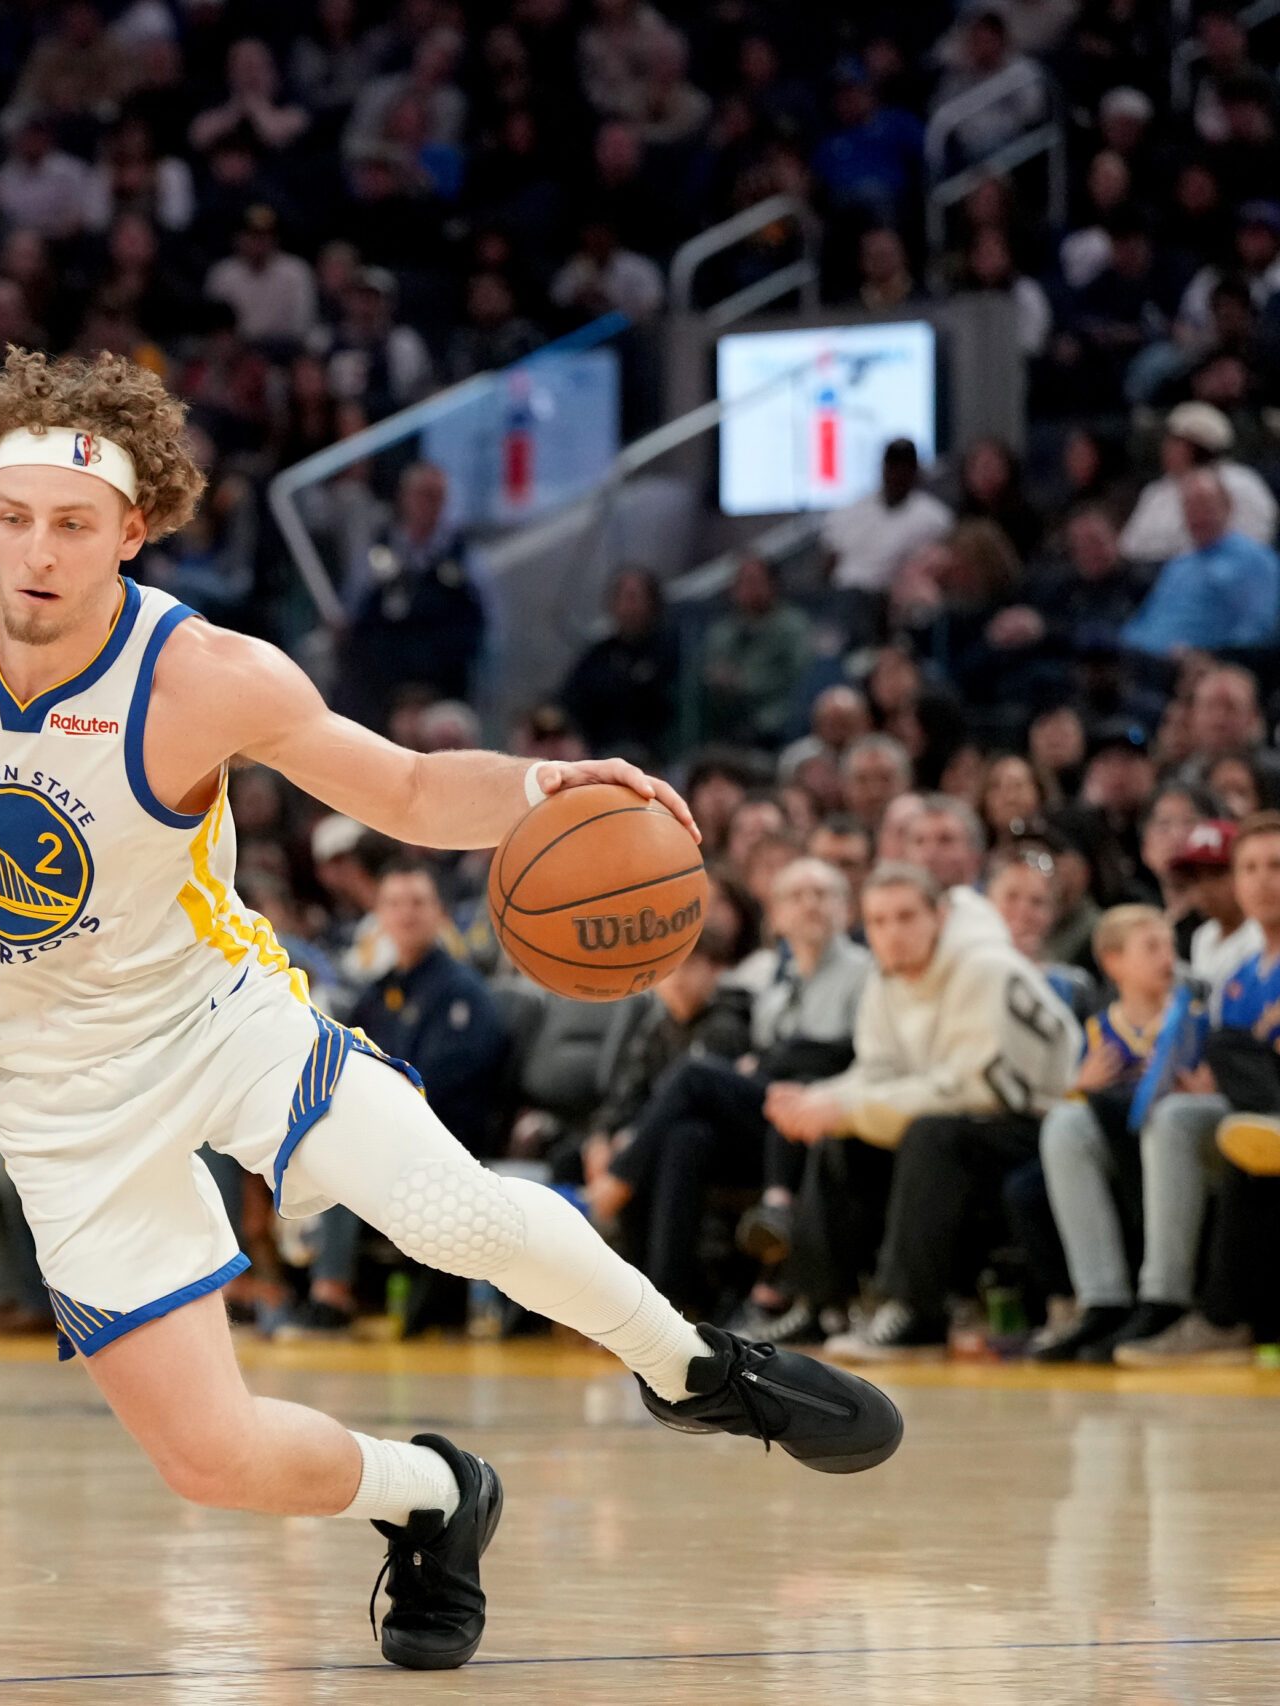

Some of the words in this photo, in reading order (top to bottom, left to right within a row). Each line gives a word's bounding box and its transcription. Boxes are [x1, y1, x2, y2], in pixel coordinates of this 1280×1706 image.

[49, 713, 119, 735] Rakuten
[31, 771, 96, 828] STATE
[34, 831, 64, 876] 2
[572, 896, 702, 951] Wilson
